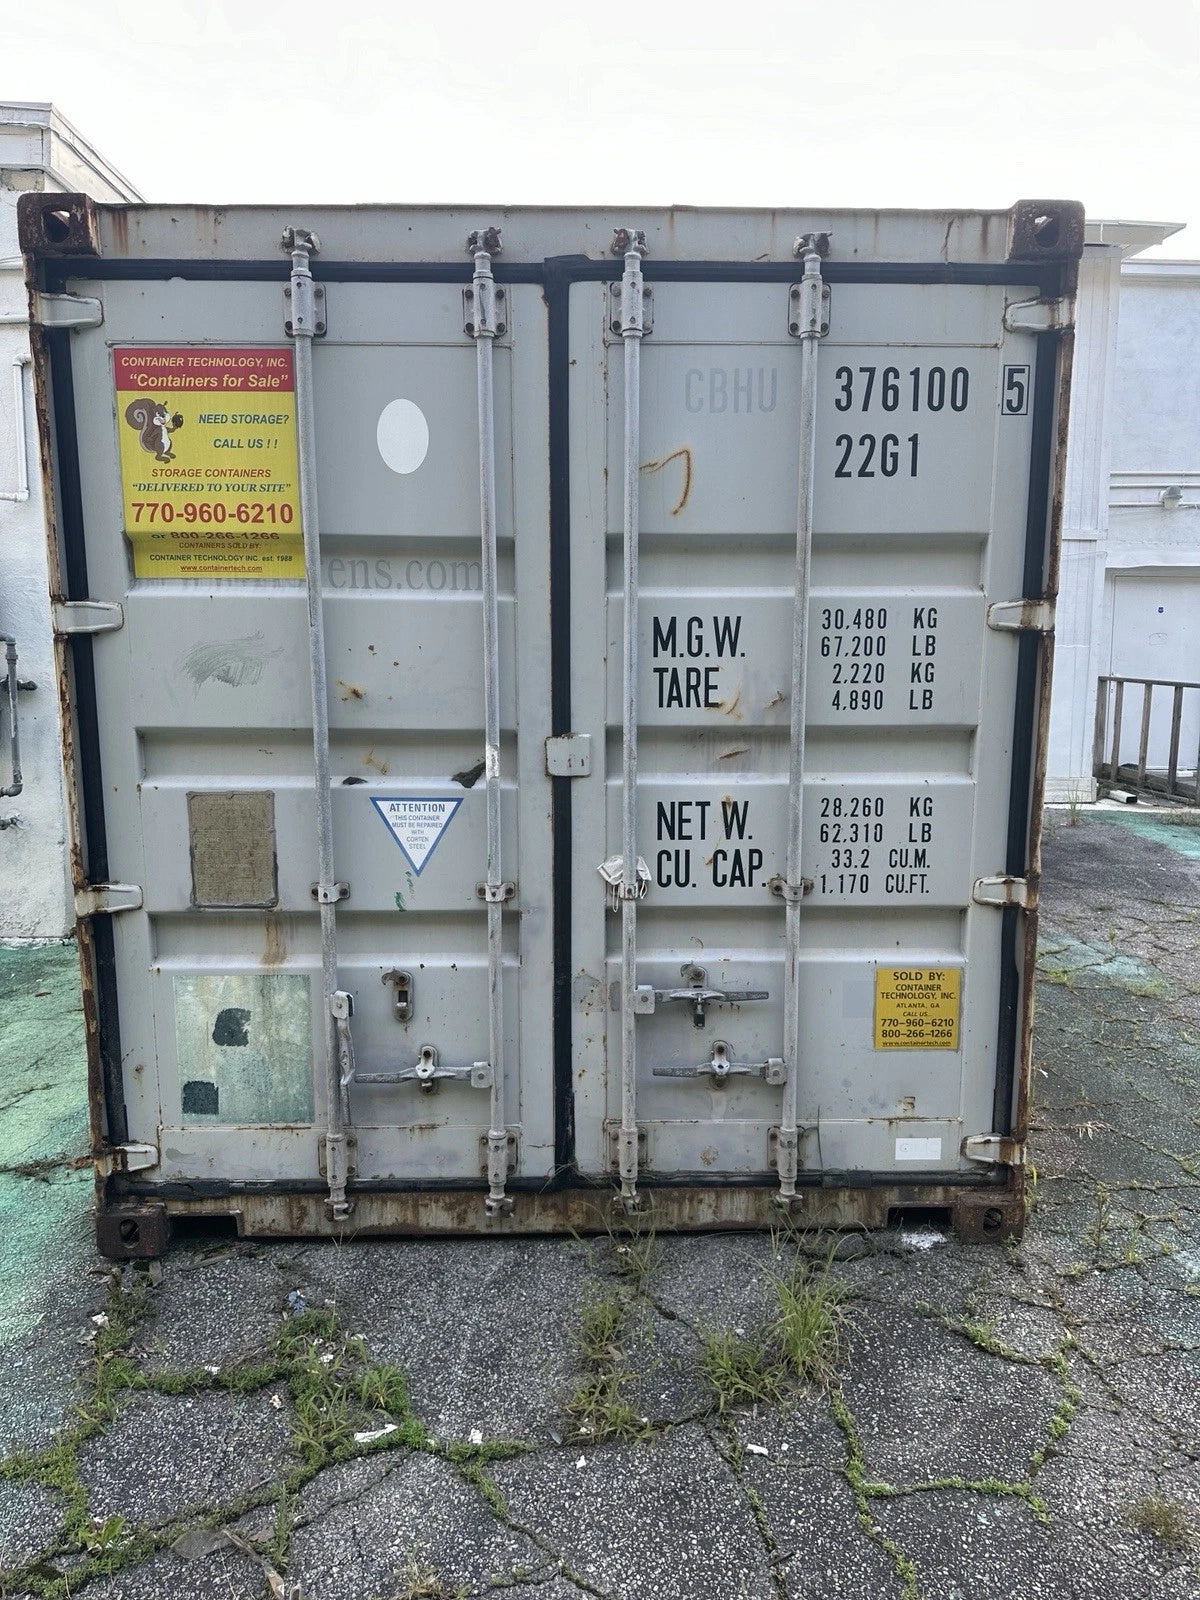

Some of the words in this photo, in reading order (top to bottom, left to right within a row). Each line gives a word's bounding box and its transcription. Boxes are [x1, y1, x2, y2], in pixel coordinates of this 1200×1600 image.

[122, 358, 184, 367] CONTAINER
[187, 357, 263, 368] TECHNOLOGY,
[267, 358, 287, 367] INC.
[223, 374, 243, 387] for
[684, 368, 778, 414] CBHU
[834, 366, 969, 412] 376100
[1006, 368, 1026, 413] 5
[199, 415, 228, 424] NEED
[231, 415, 289, 424] STORAGE?
[213, 439, 244, 448] CALL
[247, 439, 263, 448] US
[834, 433, 919, 478] 22G1
[152, 469, 202, 478] STORAGE
[205, 469, 271, 478] CONTAINERS
[207, 484, 221, 492] TO
[225, 484, 256, 492] YOUR
[132, 503, 293, 523] 770-960-6210
[914, 608, 937, 628] KG
[652, 616, 746, 658] M.G.W.
[912, 635, 936, 656] LB
[911, 663, 934, 683] KG
[653, 667, 720, 708] TARE
[909, 689, 933, 709] LB
[390, 804, 445, 812] ATTENTION
[910, 797, 933, 817] KG
[657, 801, 710, 840] NET
[722, 801, 752, 840] W.
[909, 823, 932, 842] LB
[832, 849, 870, 868] 33.2
[889, 849, 930, 868] CU.M.
[656, 850, 696, 888] CU.
[712, 849, 767, 888] CAP.
[886, 874, 929, 893] CU.FT.
[893, 972, 922, 980] SOLD
[929, 972, 945, 981] BY:
[882, 1030, 952, 1038] 800-266-1266
